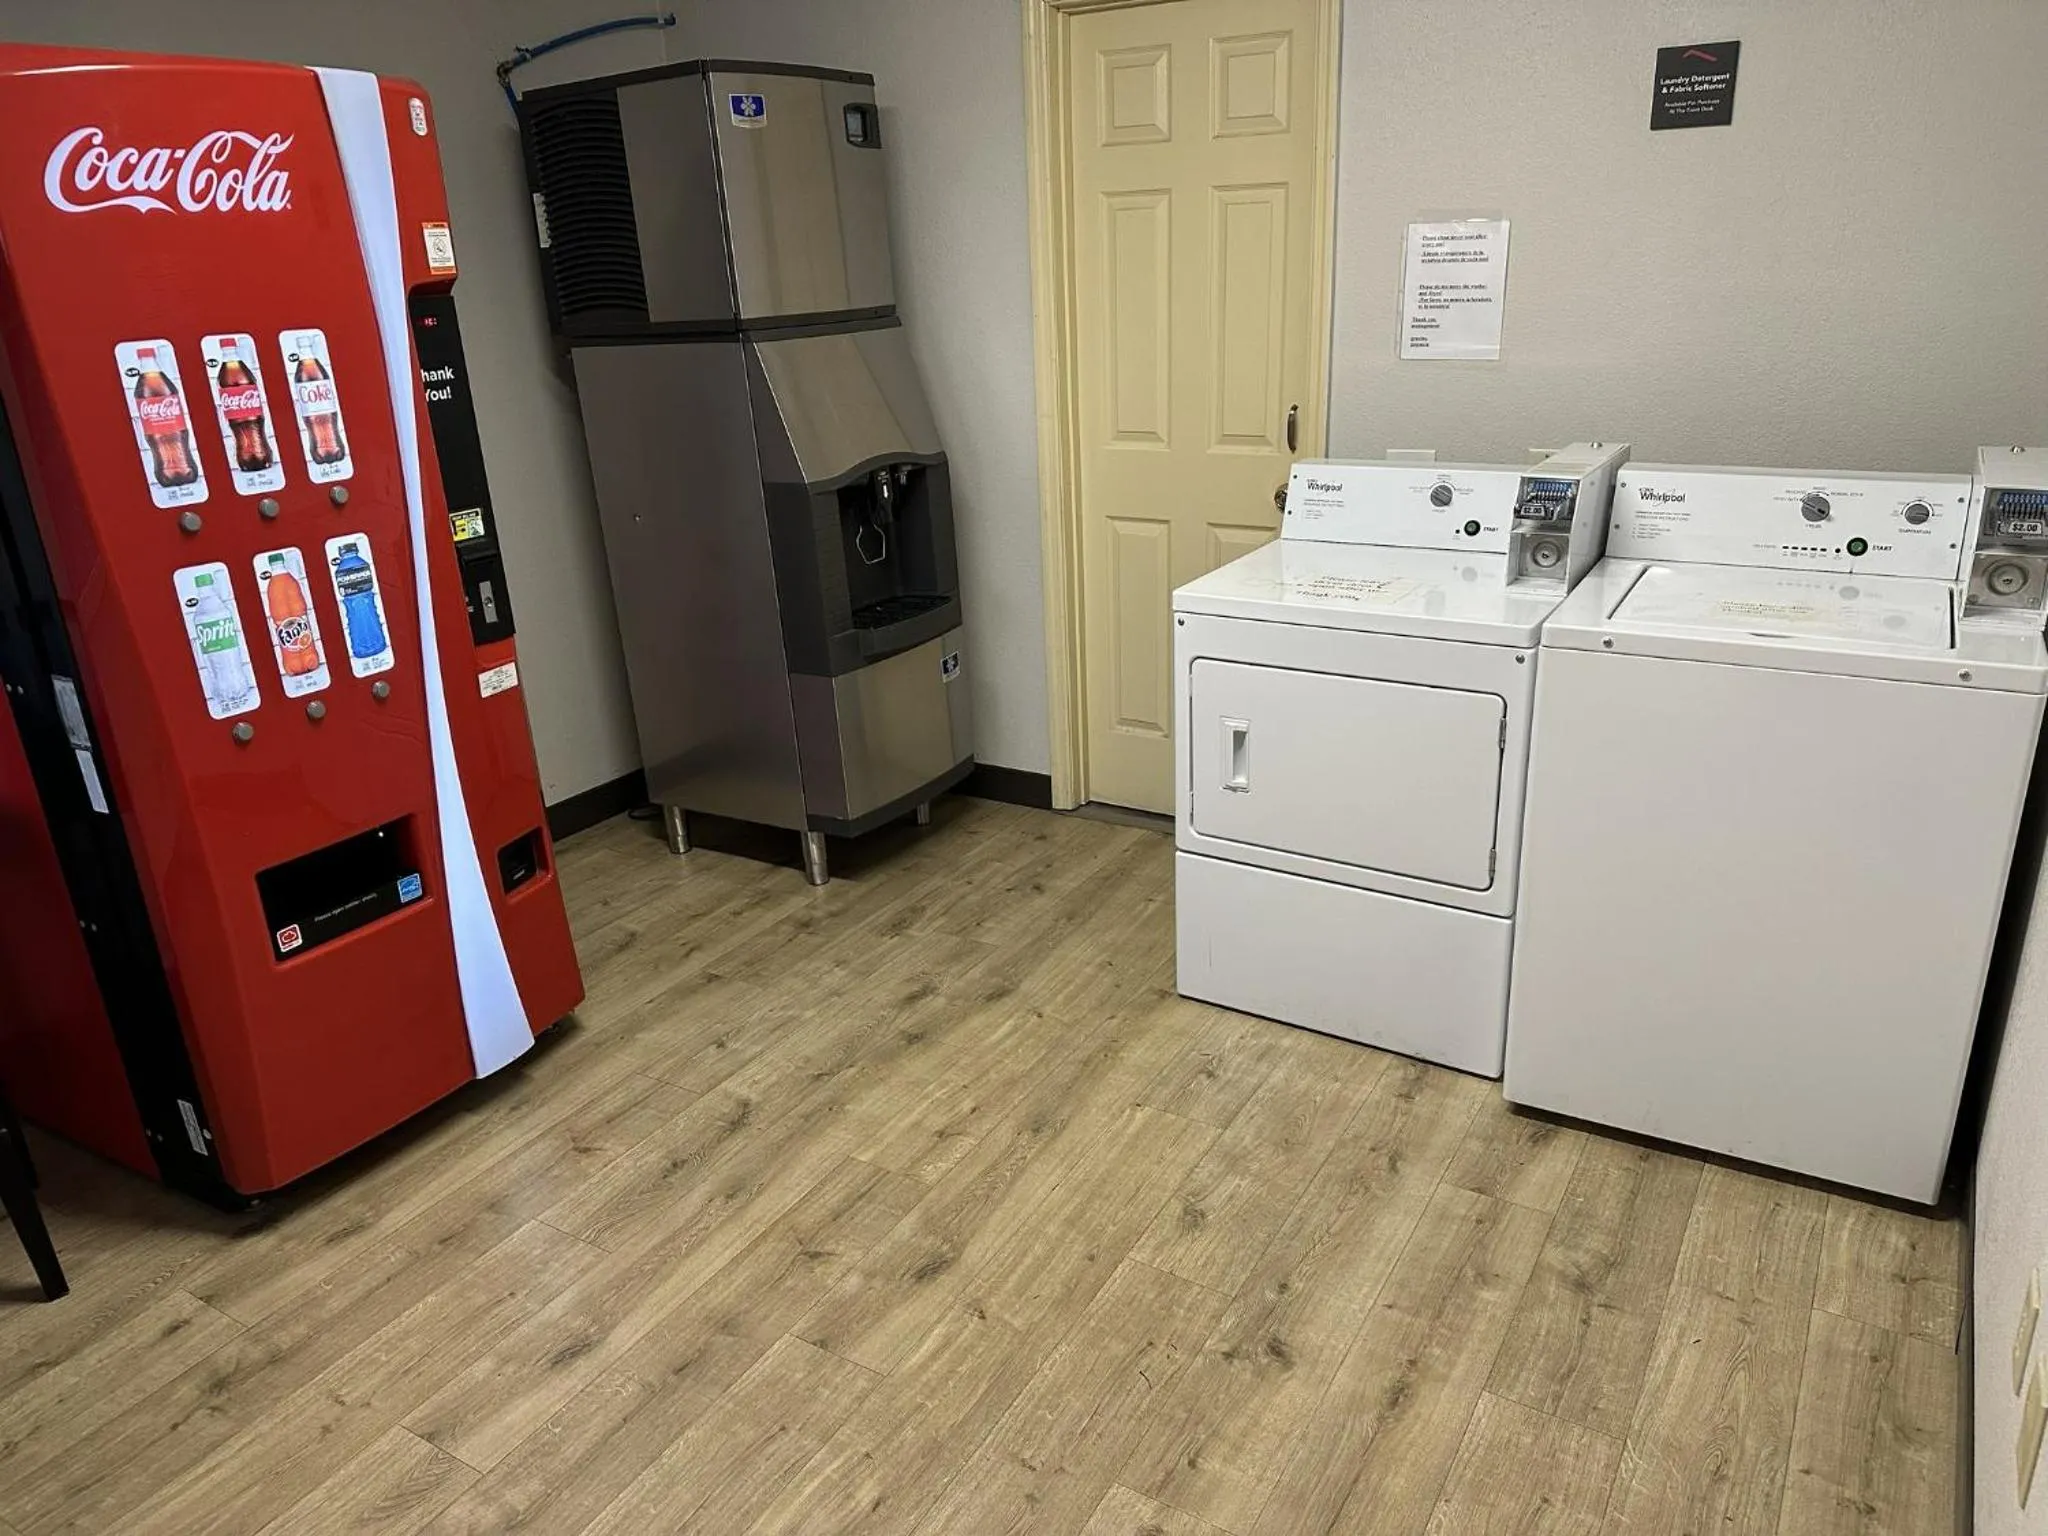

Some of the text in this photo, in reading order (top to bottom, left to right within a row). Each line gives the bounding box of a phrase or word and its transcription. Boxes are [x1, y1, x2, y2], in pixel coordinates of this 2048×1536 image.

[1660, 73, 1730, 85] Laundry Detergent
[1669, 85, 1692, 93] Fabric
[1694, 83, 1727, 91] Softener
[44, 127, 295, 215] Coca-Cola
[420, 365, 455, 382] hank
[221, 390, 261, 411] Coca-Cola
[299, 384, 332, 404] Coke
[141, 397, 181, 419] Coca-Cola
[1307, 482, 1343, 493] Whirlpool
[1640, 490, 1686, 504] Whirlpool
[2012, 523, 2038, 532] $2.00
